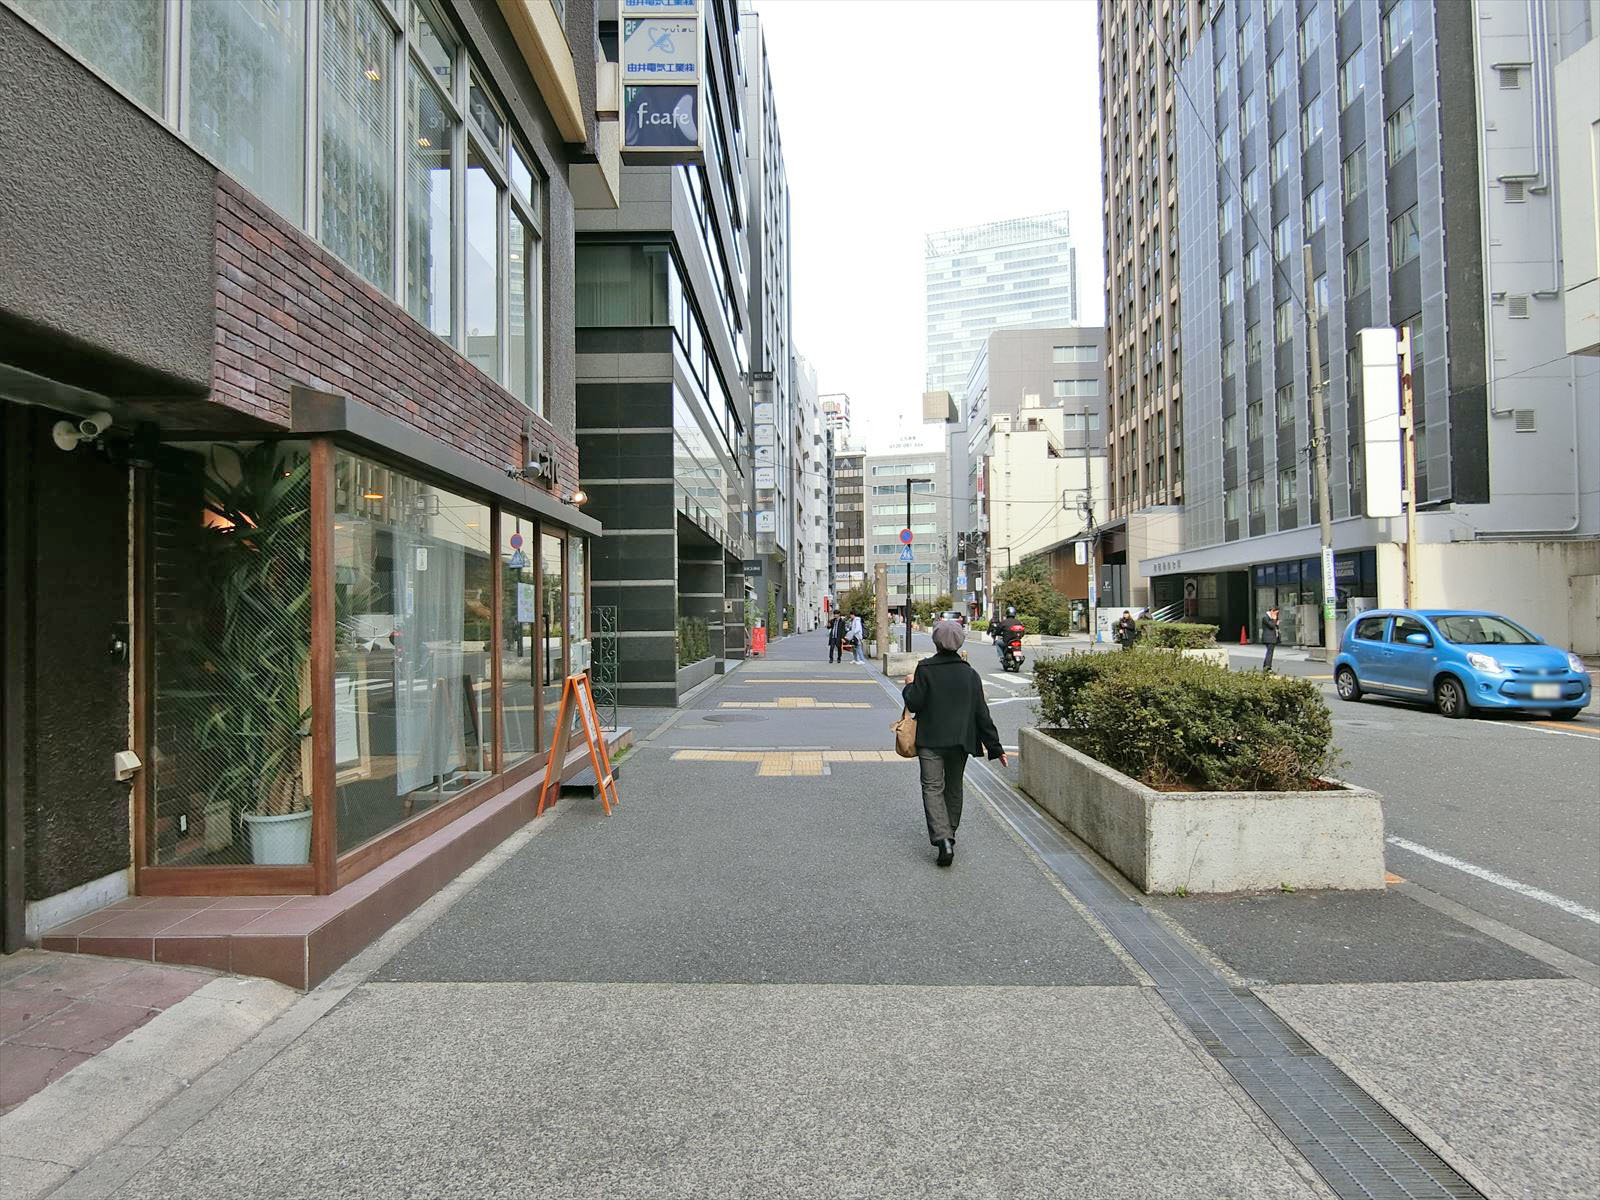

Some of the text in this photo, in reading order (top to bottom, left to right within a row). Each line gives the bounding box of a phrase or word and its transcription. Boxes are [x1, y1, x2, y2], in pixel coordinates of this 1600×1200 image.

[626, 21, 636, 36] 2F
[627, 88, 636, 101] 1F
[637, 103, 690, 128] f.cafe
